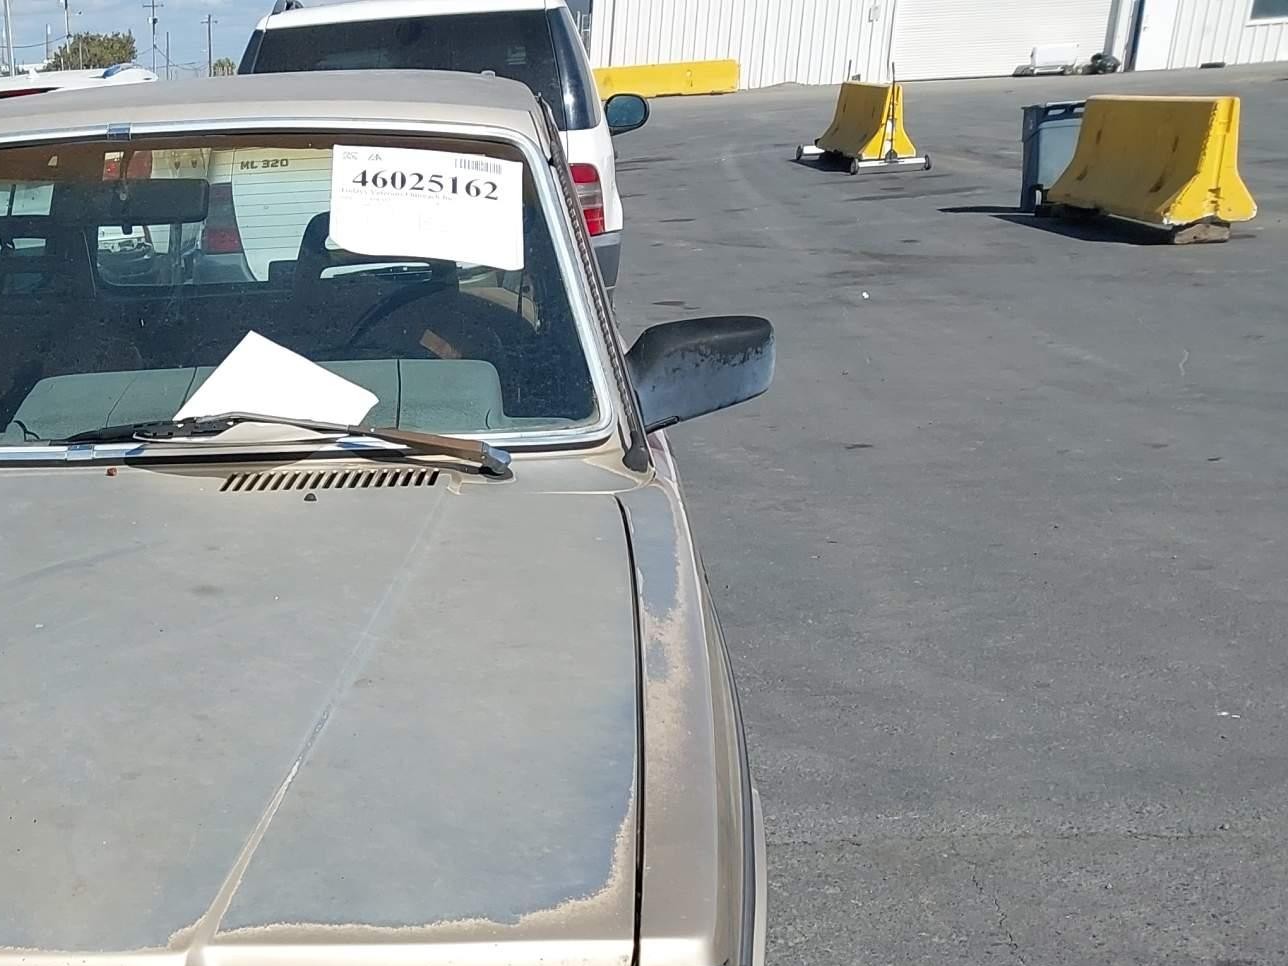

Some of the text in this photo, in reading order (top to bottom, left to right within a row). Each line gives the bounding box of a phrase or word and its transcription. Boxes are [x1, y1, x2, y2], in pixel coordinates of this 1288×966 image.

[240, 159, 289, 170] ML 320
[352, 169, 499, 200] 46025162
